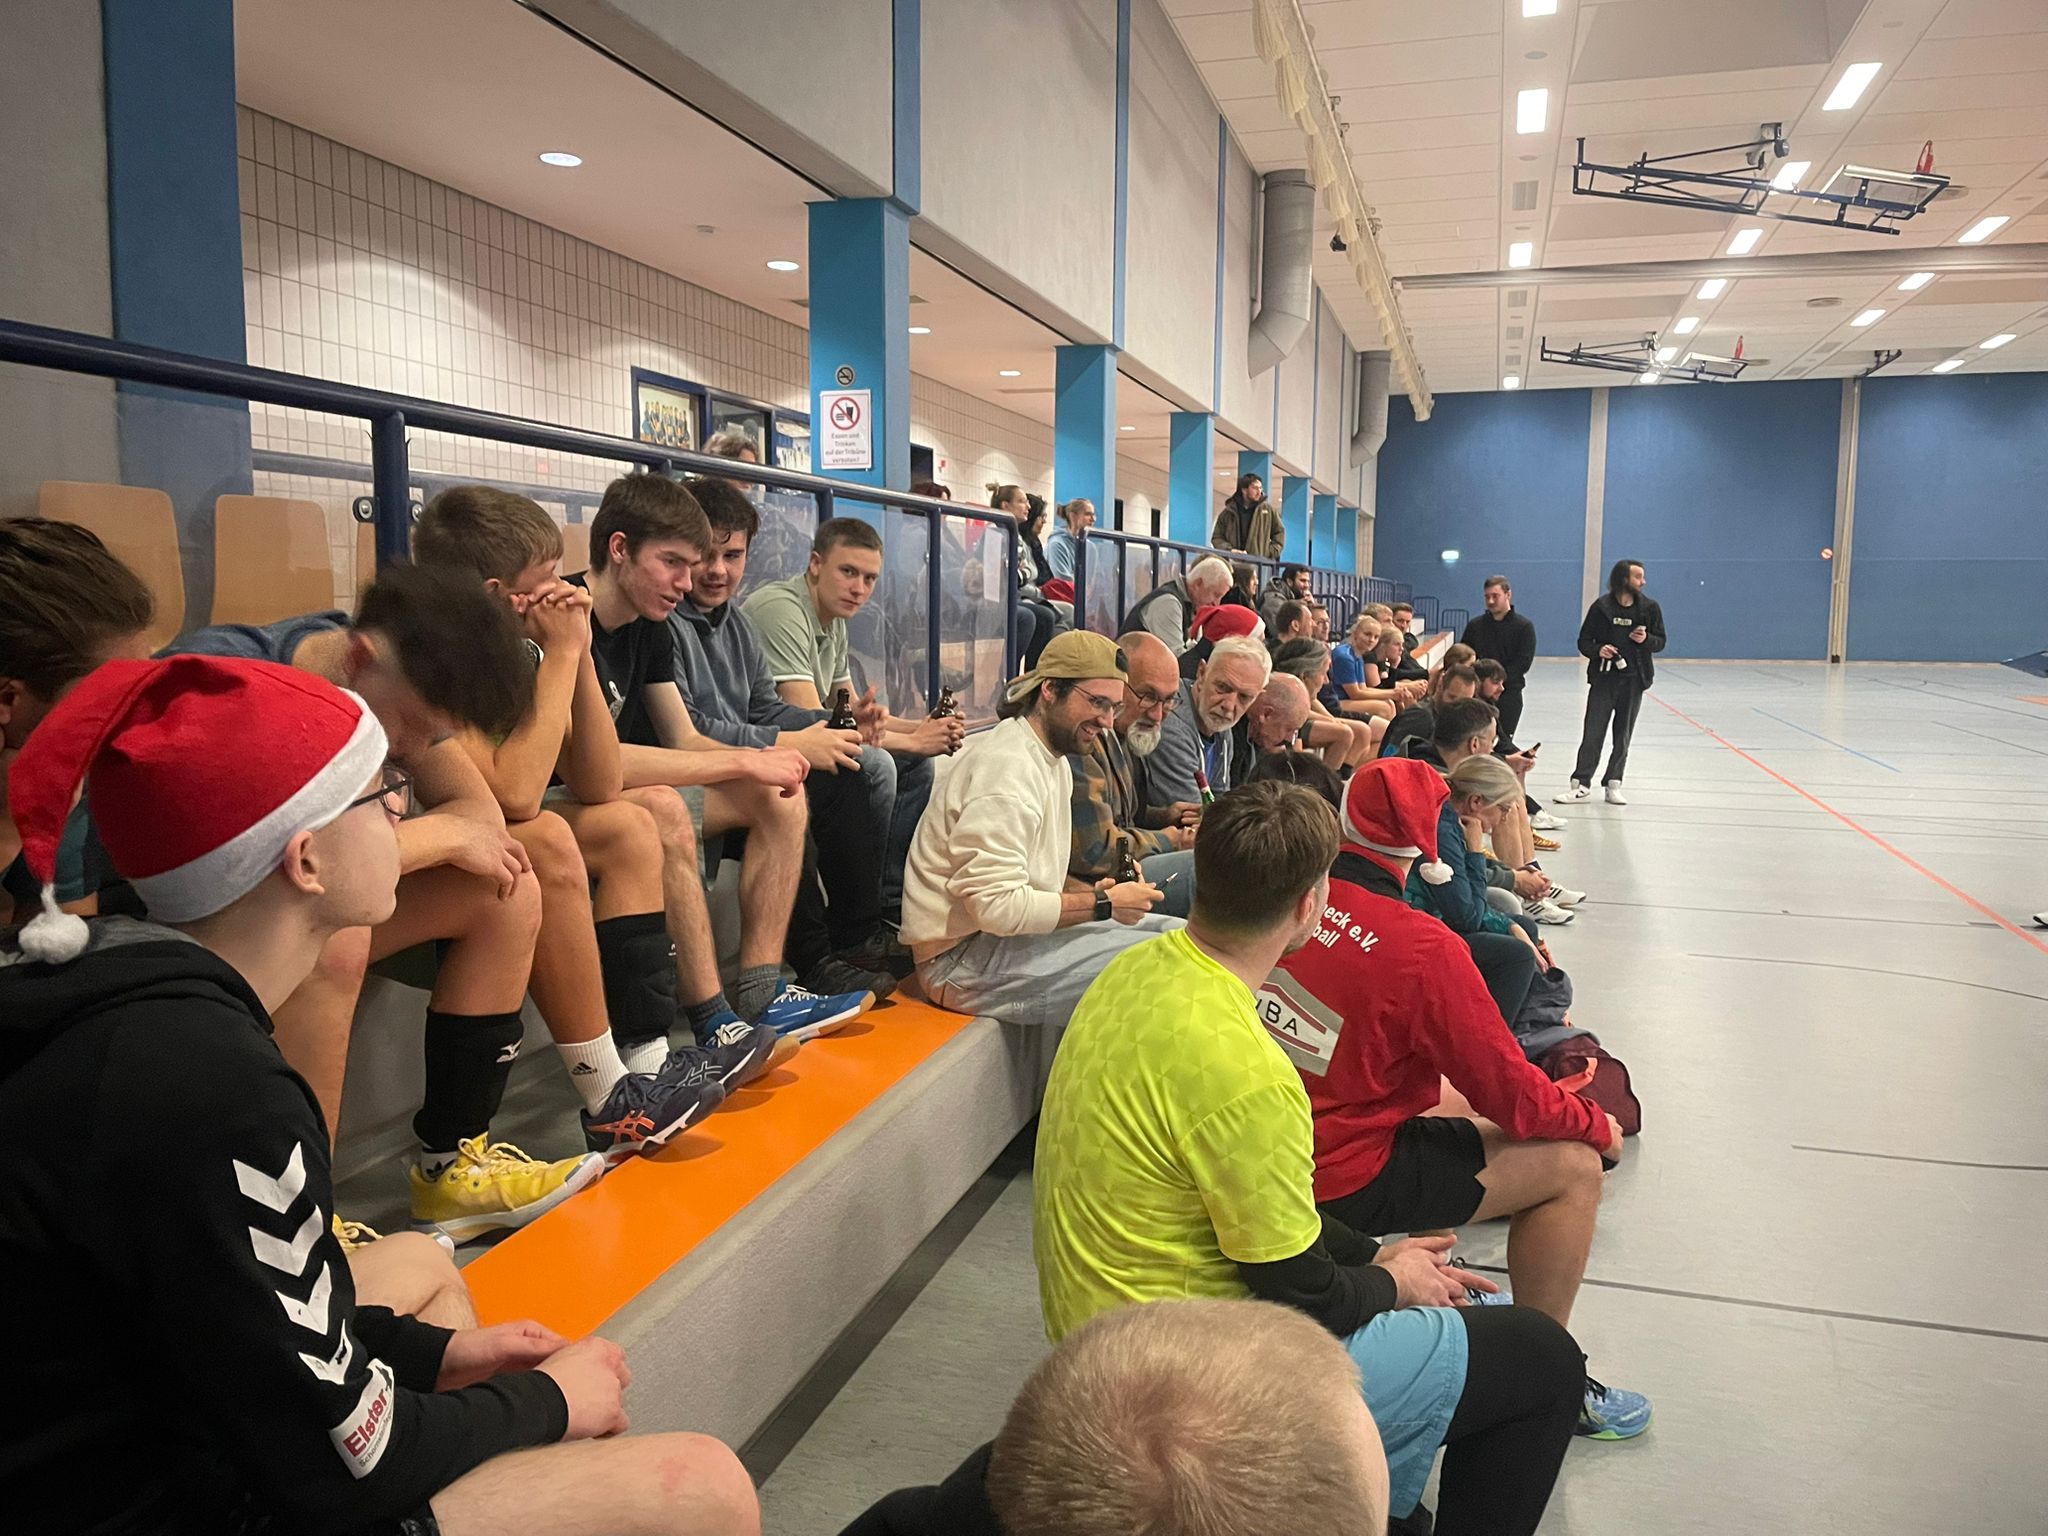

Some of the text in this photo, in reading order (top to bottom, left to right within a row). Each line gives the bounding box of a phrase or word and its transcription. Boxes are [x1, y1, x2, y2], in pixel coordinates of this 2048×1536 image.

[1322, 903, 1379, 953] eck e.V.
[343, 1389, 387, 1457] Elster
